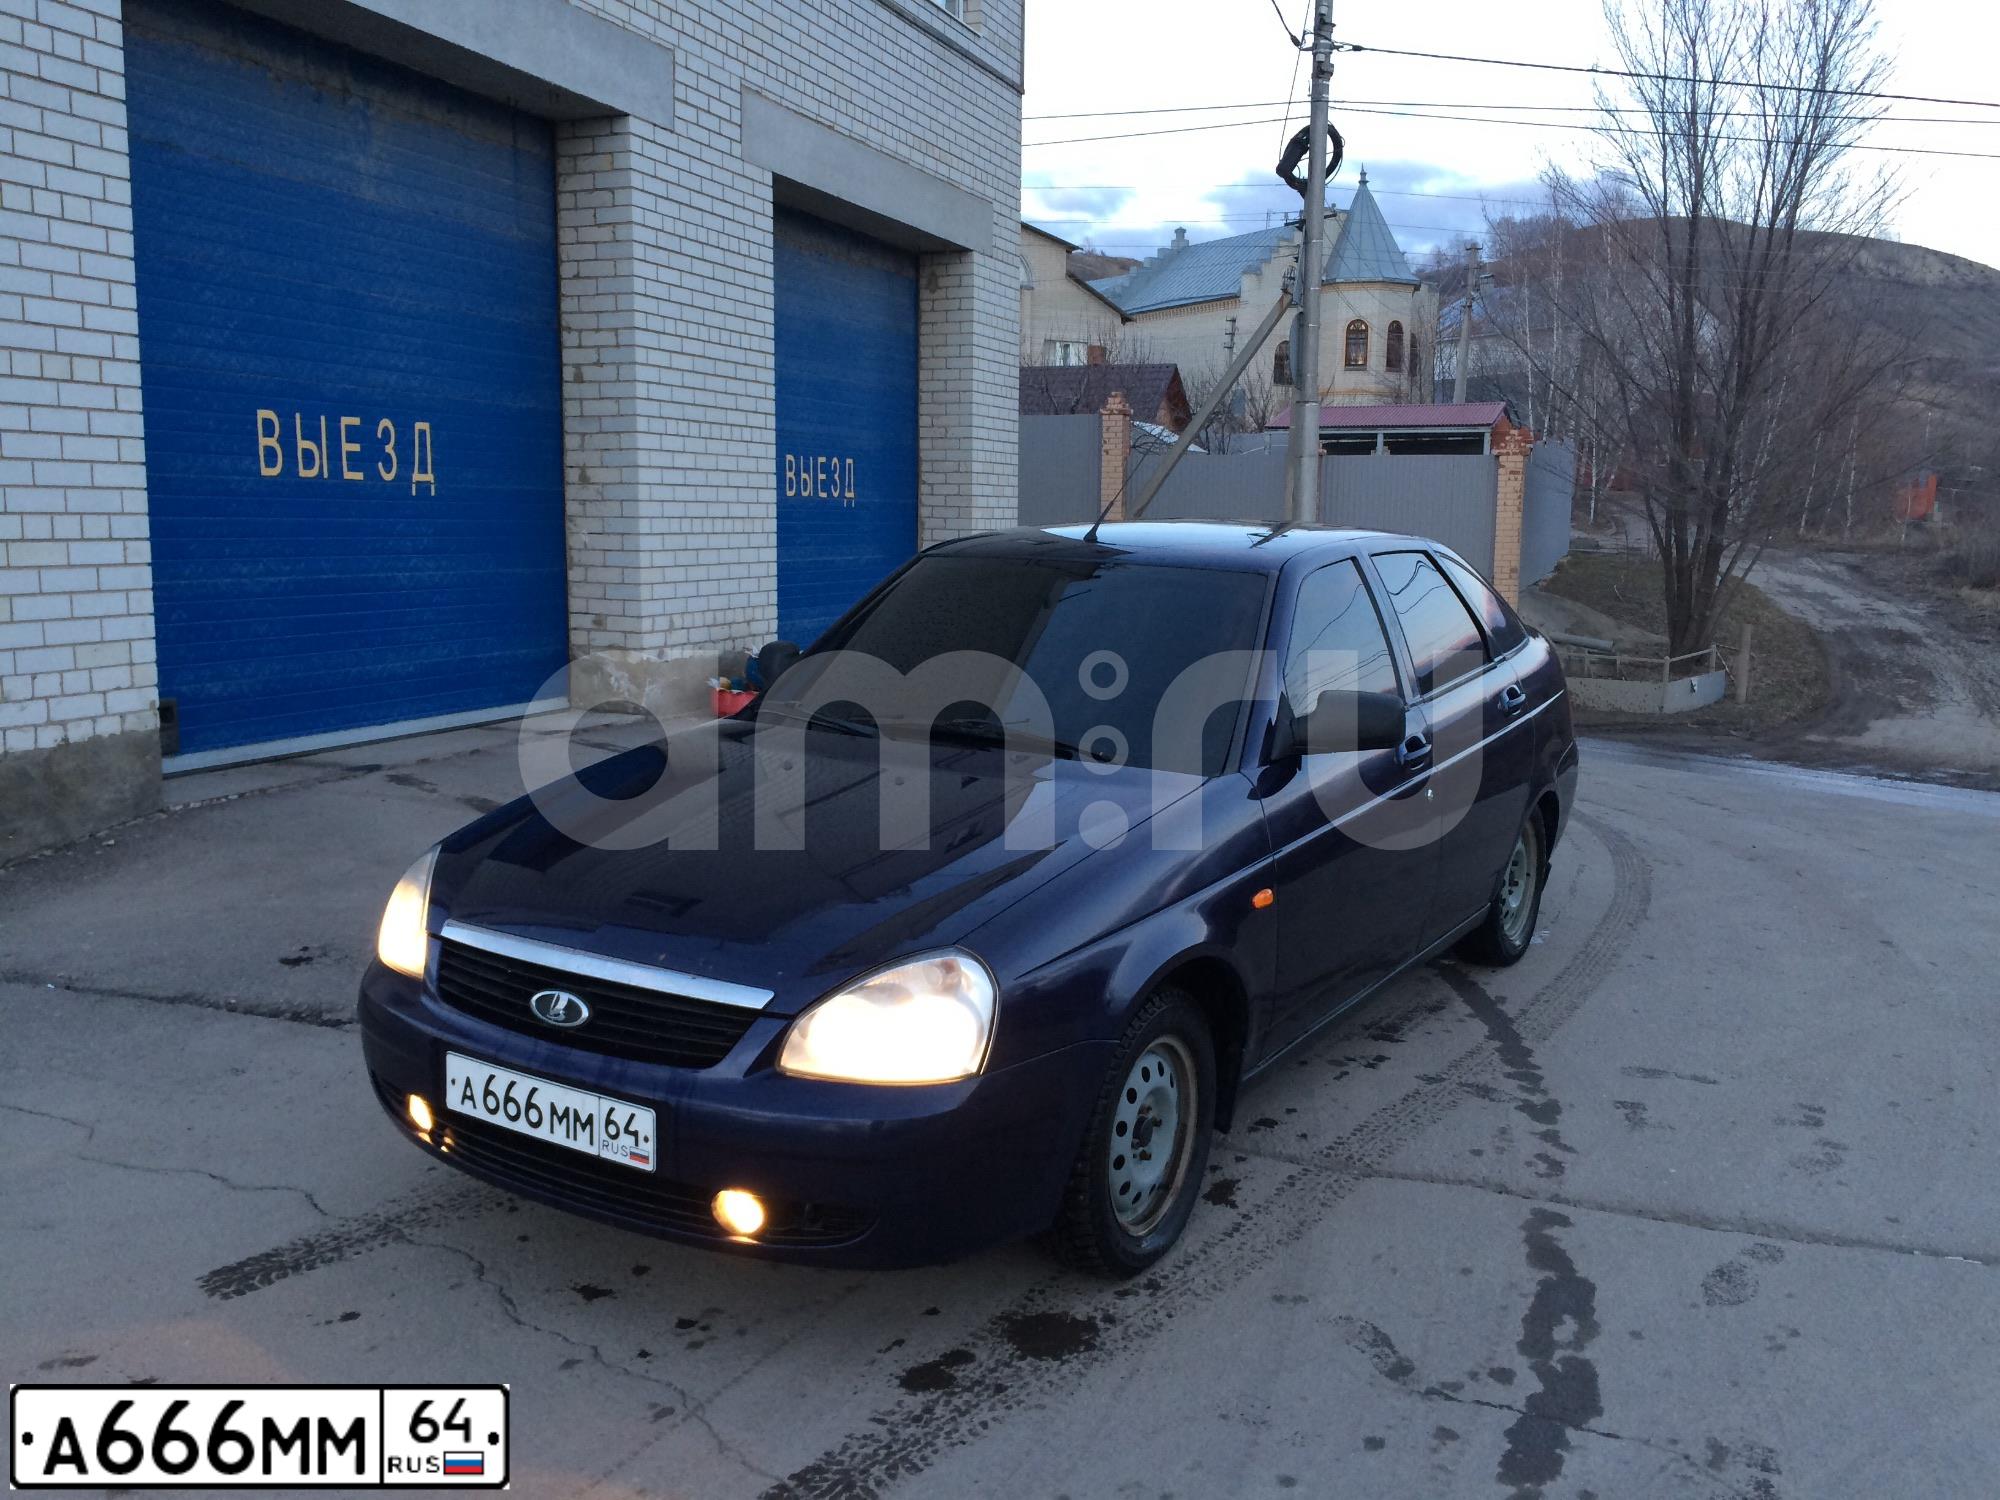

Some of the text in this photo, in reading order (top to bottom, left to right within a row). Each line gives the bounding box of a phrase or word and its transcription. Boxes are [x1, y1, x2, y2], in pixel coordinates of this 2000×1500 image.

[257, 409, 435, 496] ВЫЕЗД
[785, 454, 855, 507] ВЫЕЗД
[601, 1139, 629, 1158] RUS
[604, 1106, 639, 1147] 64
